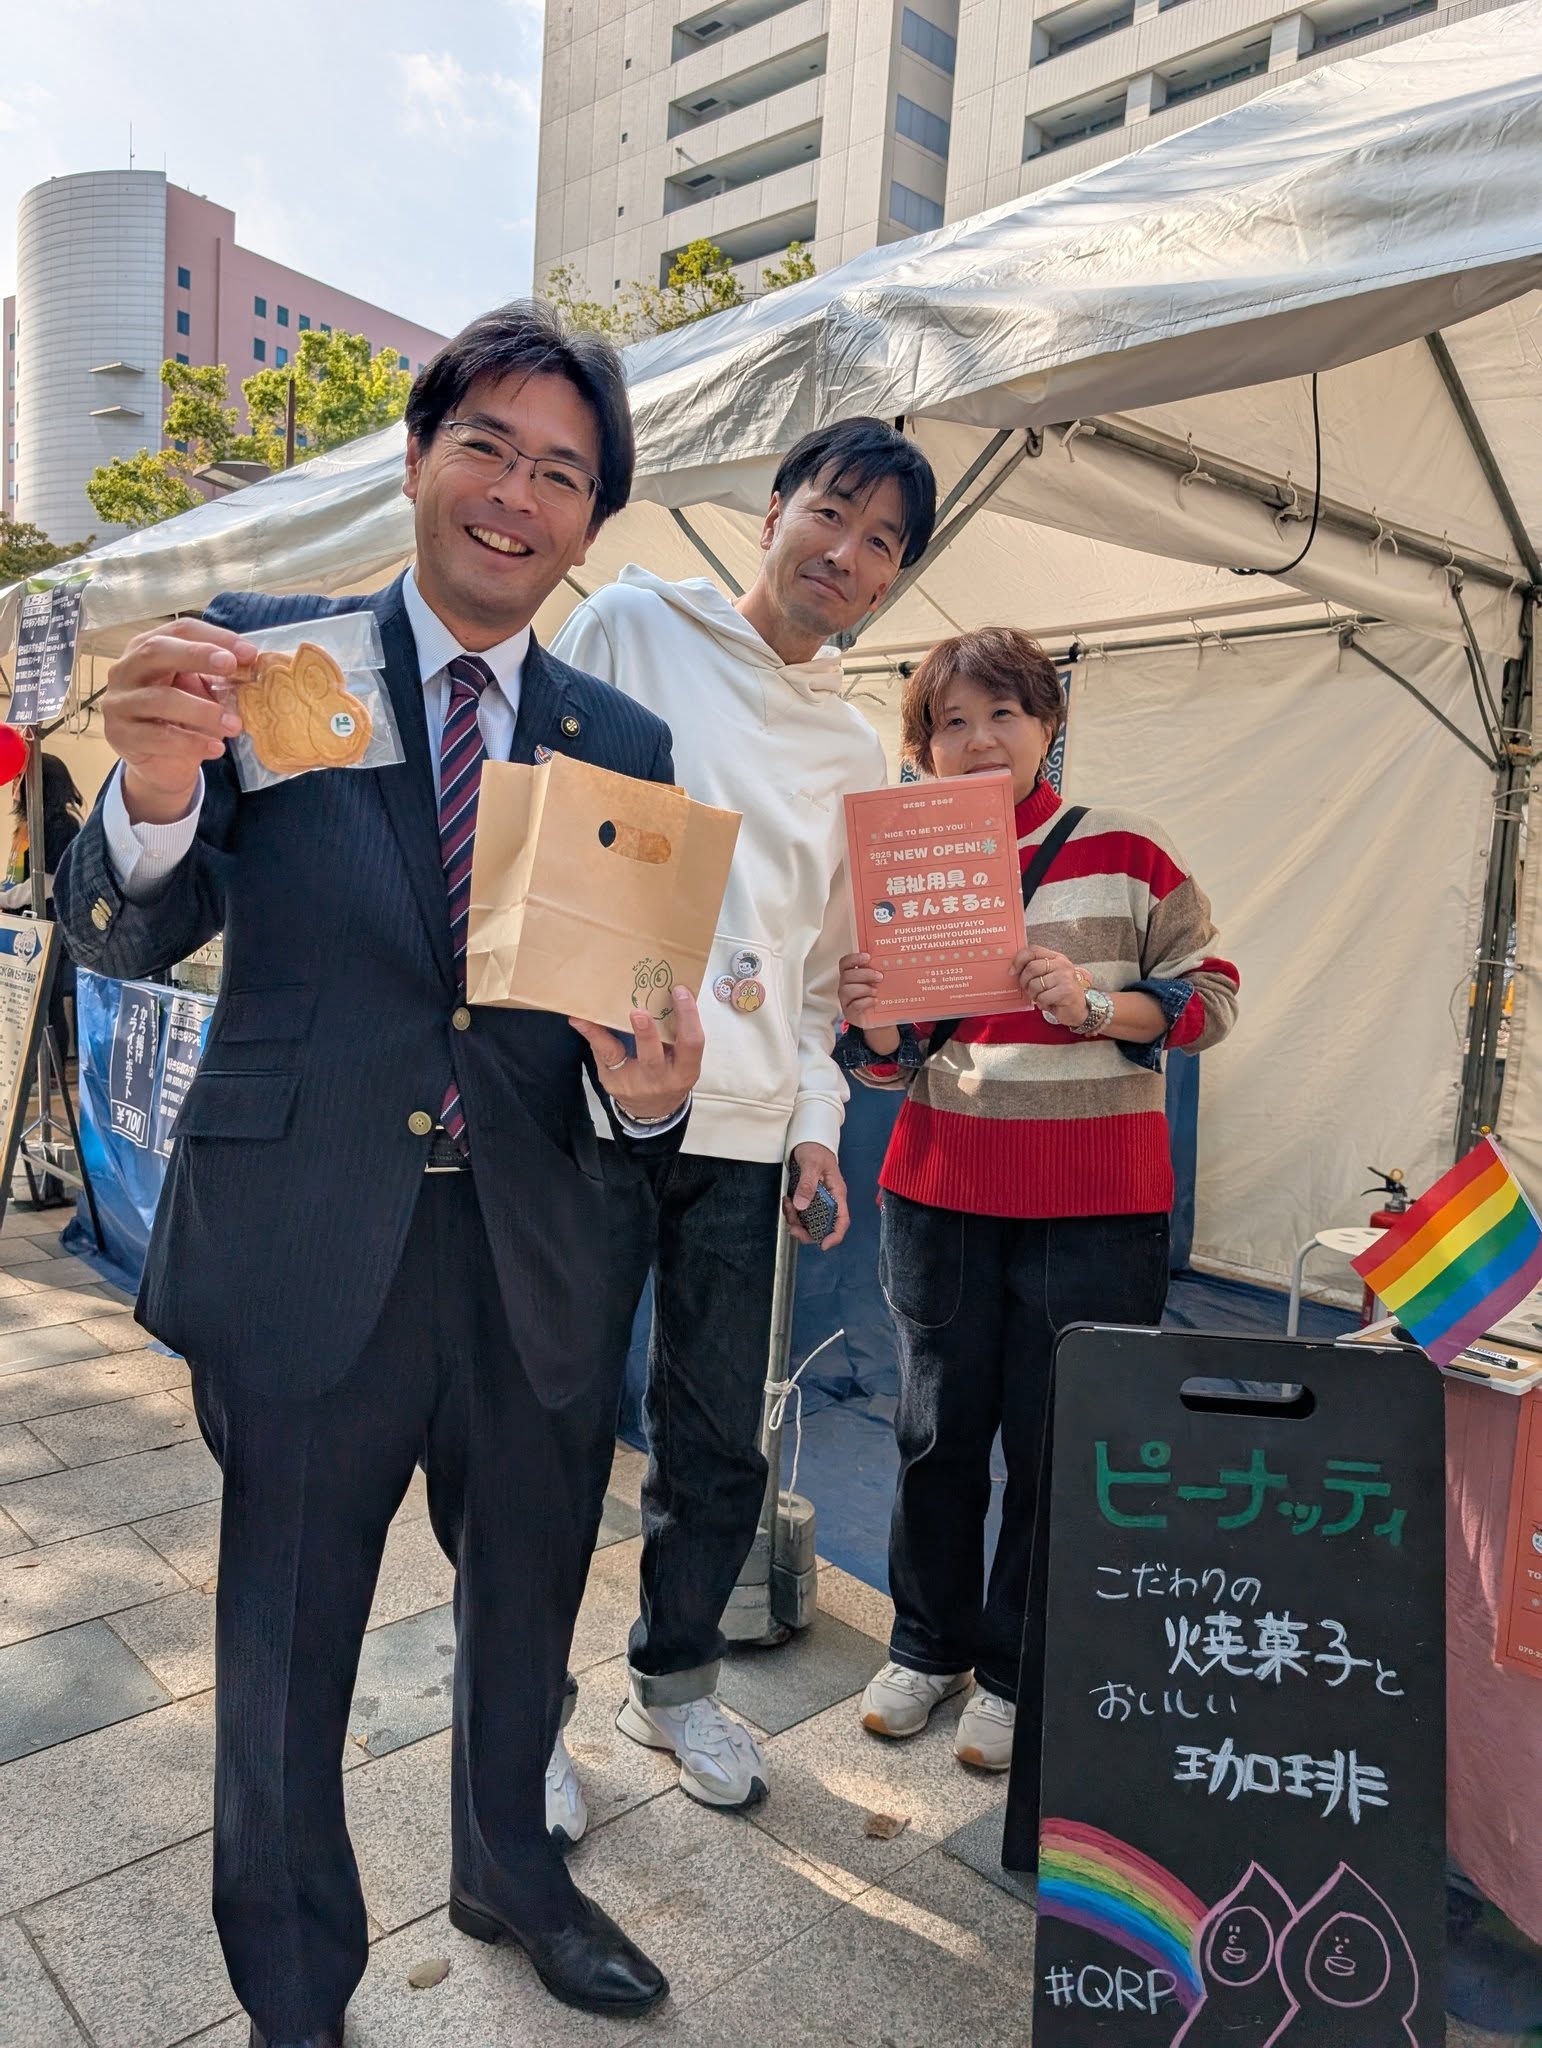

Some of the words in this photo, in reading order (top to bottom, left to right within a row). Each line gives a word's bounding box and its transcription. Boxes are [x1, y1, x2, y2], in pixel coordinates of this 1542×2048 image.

[884, 830, 904, 839] NICE
[893, 847, 929, 862] NEW
[933, 841, 981, 857] OPEN!
[875, 858, 889, 866] 3/1
[886, 869, 967, 897] 福祉用具
[901, 893, 1006, 919] まんまるさん
[125, 1004, 139, 1099] フライドポテト
[1095, 1440, 1408, 1546] ピーナッティ
[1096, 1561, 1263, 1605] こだわりの
[1165, 1610, 1405, 1697] 焼菓子と
[1089, 1680, 1238, 1722] おいしい
[1174, 1737, 1390, 1825] 珈琲
[1044, 1964, 1178, 2016] #QRP
